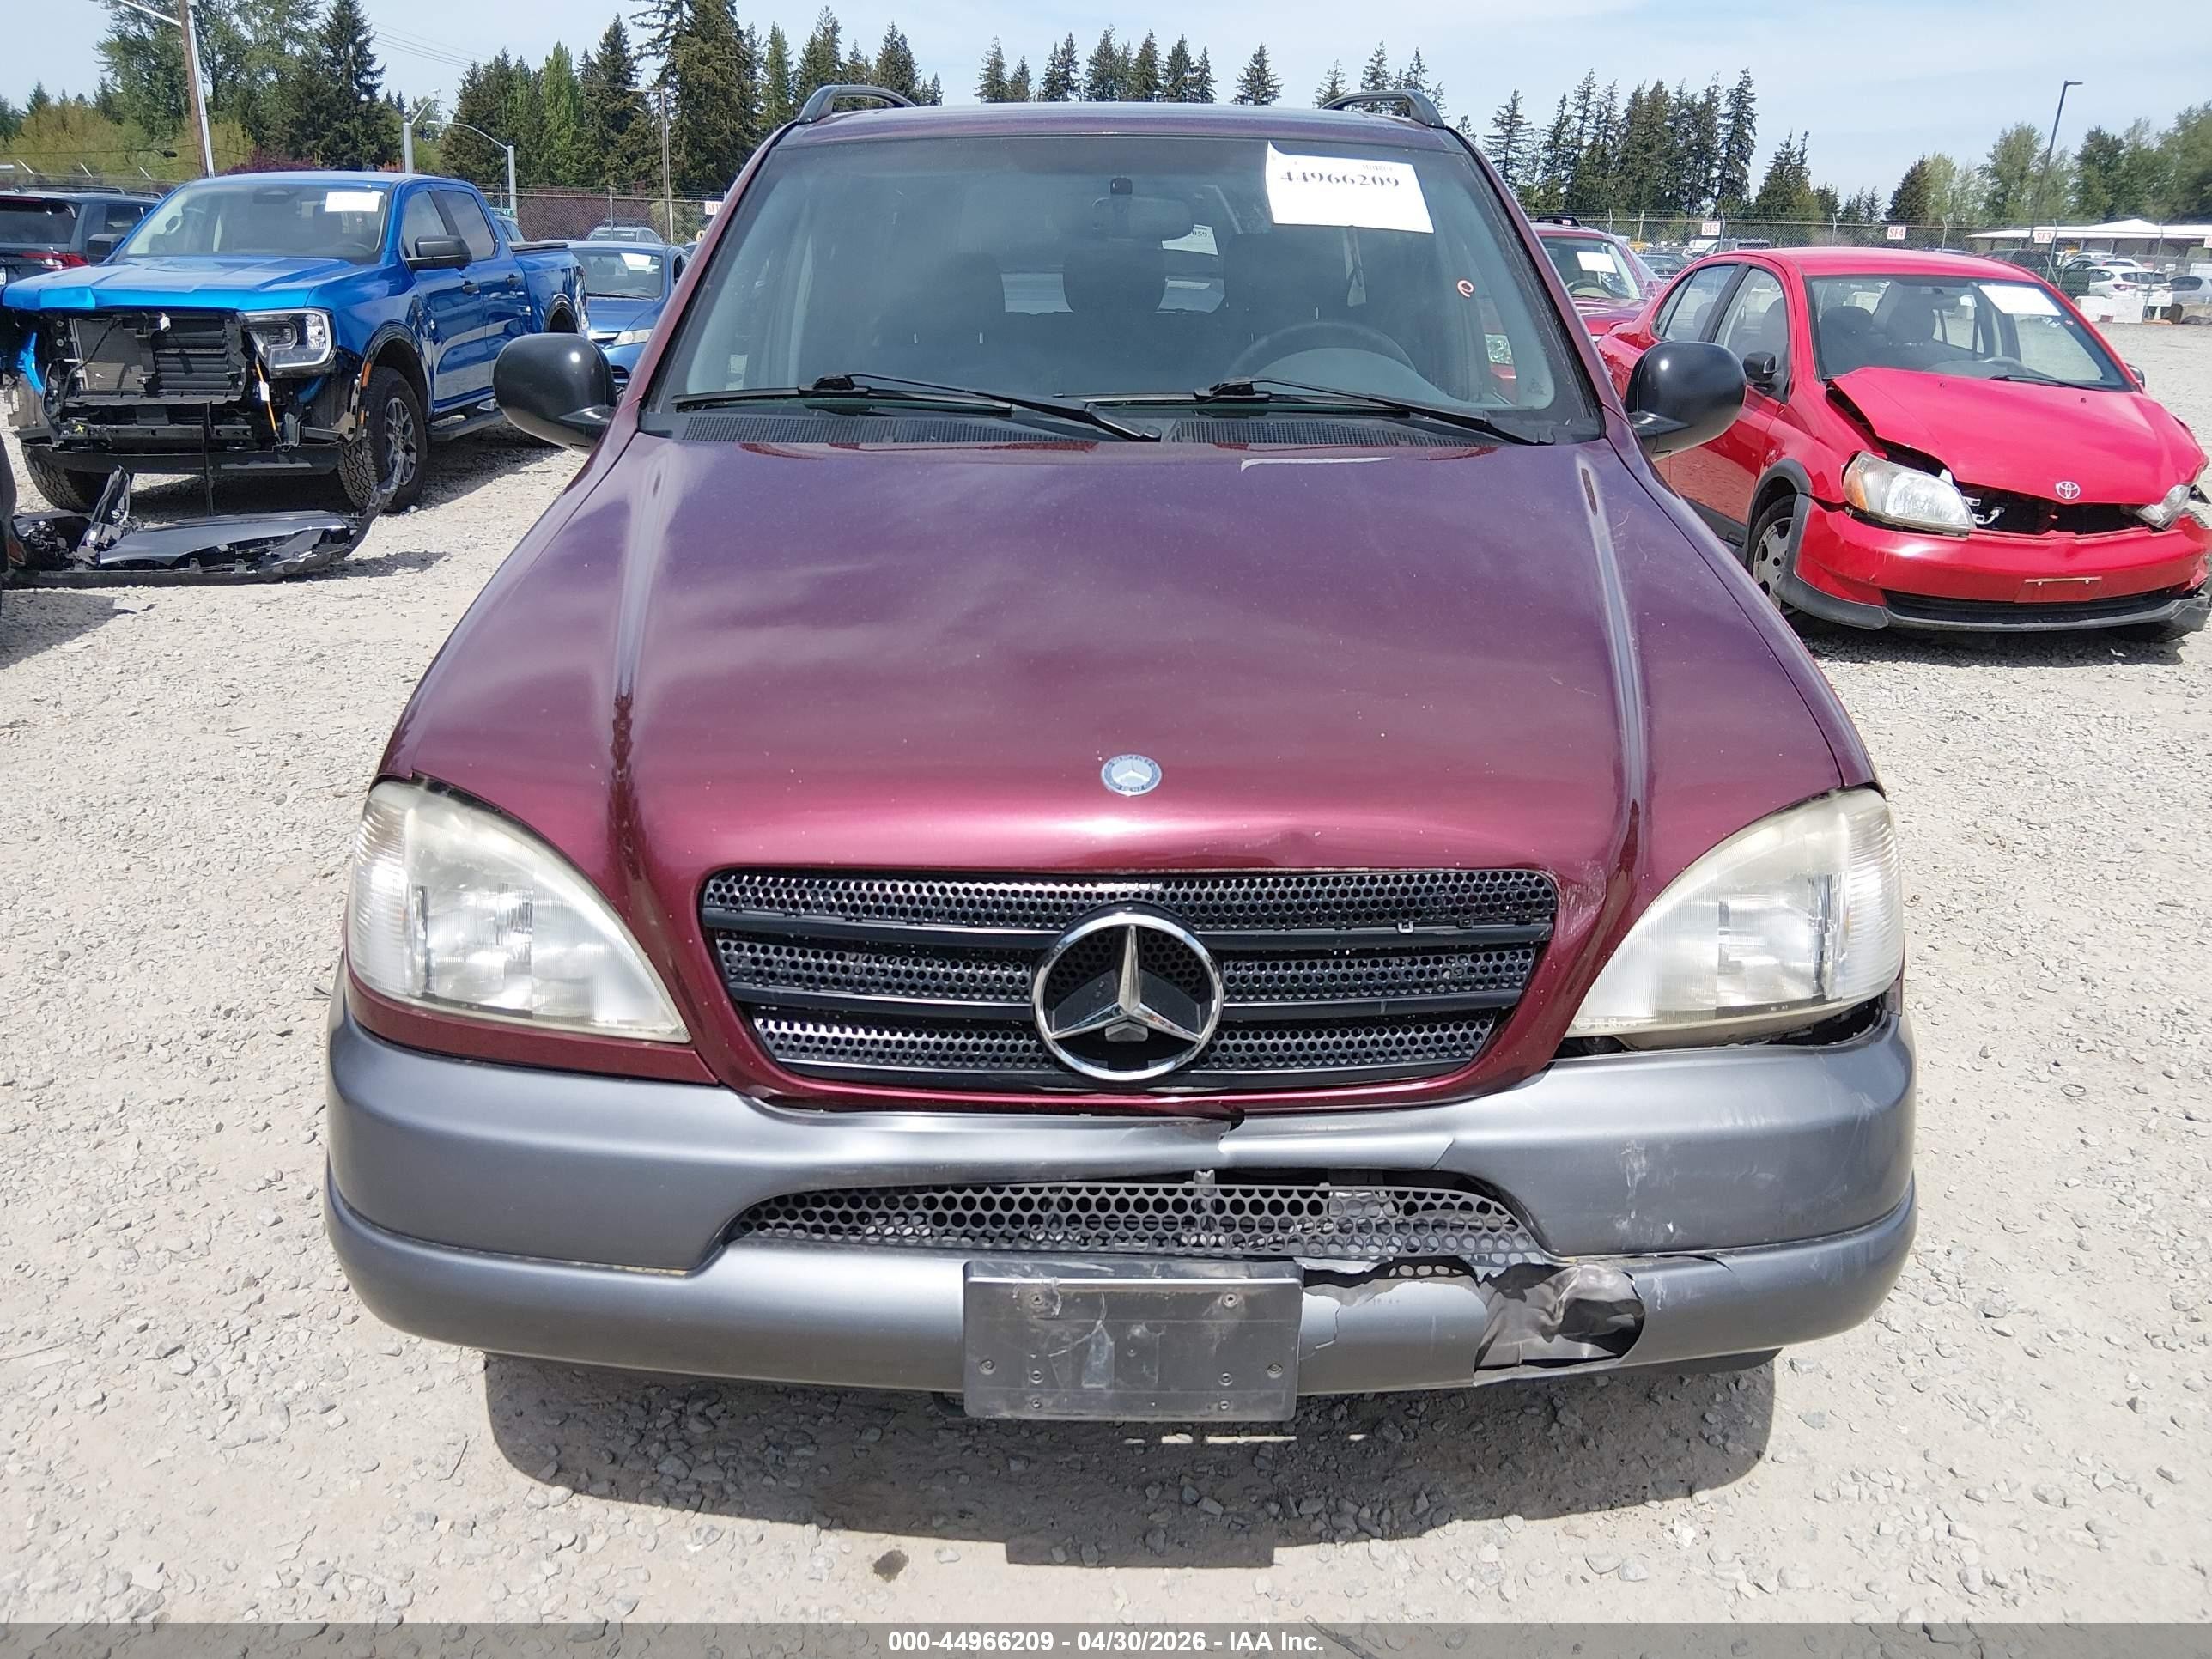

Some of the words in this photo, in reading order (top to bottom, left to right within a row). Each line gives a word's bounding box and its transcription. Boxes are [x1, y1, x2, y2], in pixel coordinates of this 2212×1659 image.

[1280, 171, 1400, 187] 44966209
[1703, 224, 1718, 234] SF5
[1888, 228, 1904, 238] SF4
[2036, 232, 2051, 242] SF3
